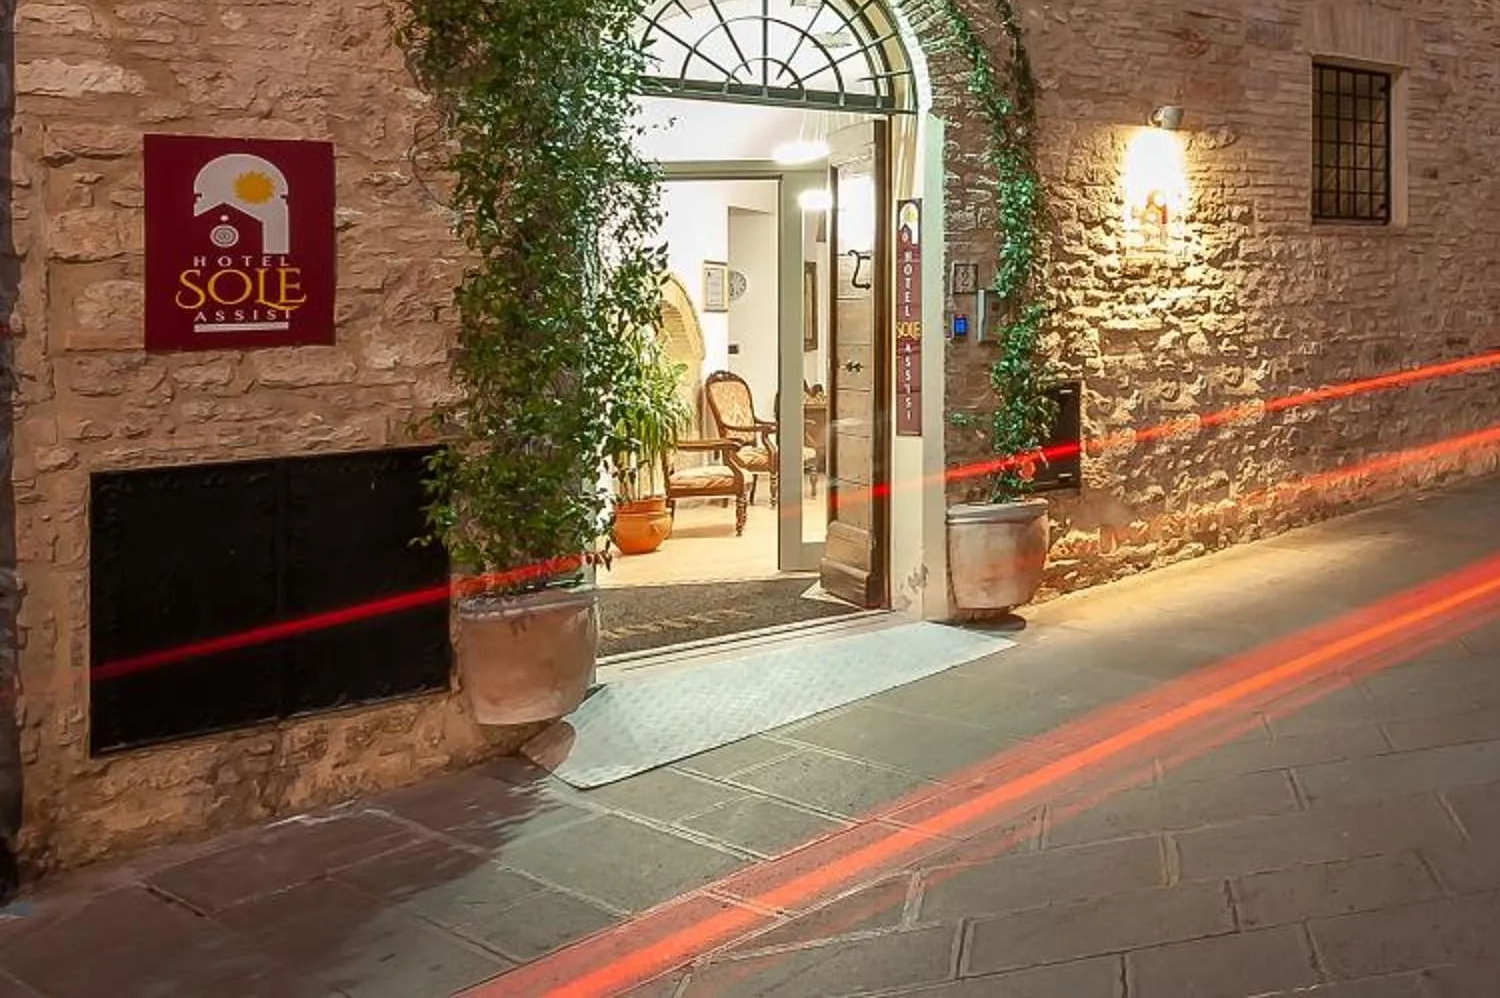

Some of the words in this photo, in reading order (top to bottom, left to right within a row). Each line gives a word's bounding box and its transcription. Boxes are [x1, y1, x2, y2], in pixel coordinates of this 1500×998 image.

[193, 255, 290, 267] HOTEL
[175, 268, 307, 311] SOLE
[903, 250, 913, 317] HOTEL
[194, 309, 290, 322] ASSISI
[904, 343, 913, 420] ASSISI
